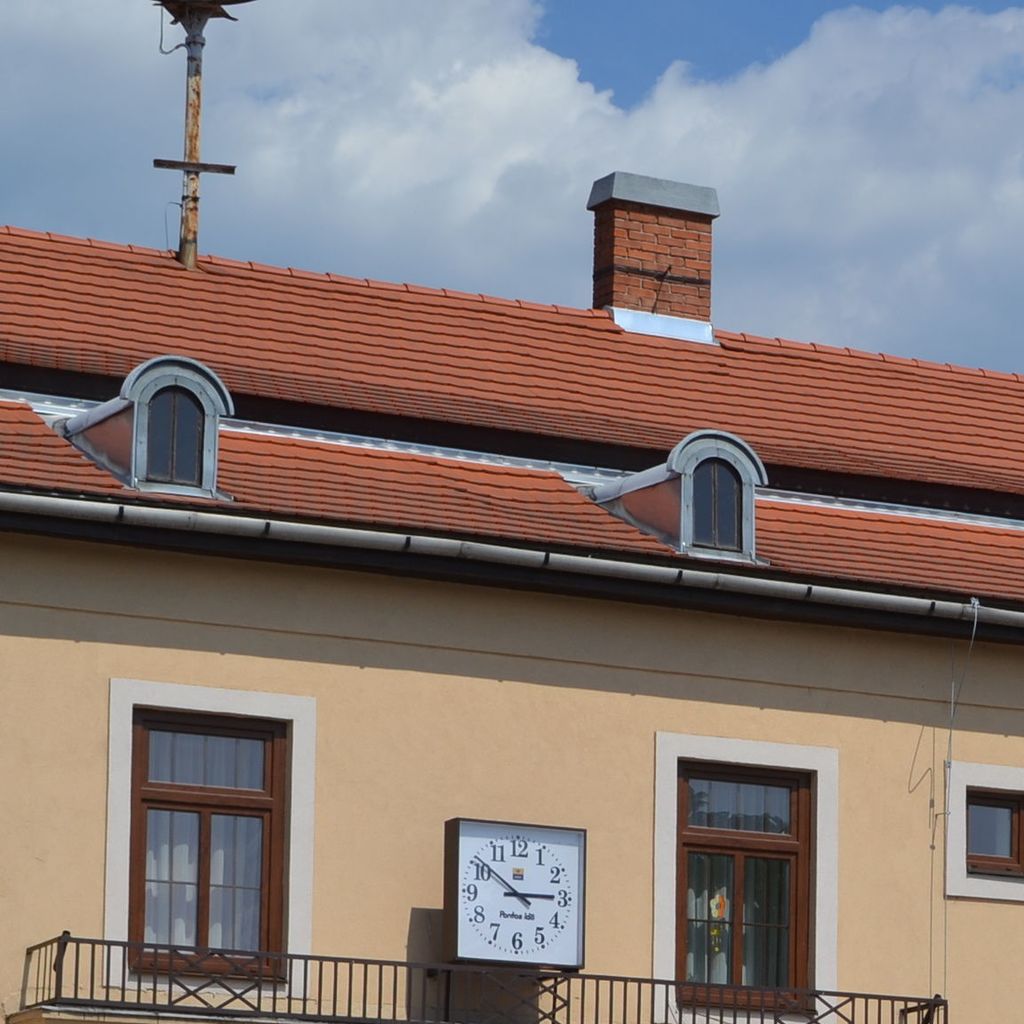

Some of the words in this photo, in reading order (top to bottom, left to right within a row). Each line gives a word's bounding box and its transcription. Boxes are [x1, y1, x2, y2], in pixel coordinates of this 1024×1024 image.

[491, 844, 505, 862] 11
[511, 839, 528, 858] 12
[536, 848, 545, 866] 1
[474, 862, 491, 881] 10
[550, 866, 561, 884] 2
[466, 884, 478, 902] 9
[558, 889, 568, 907] 3
[474, 905, 485, 923] 8
[499, 910, 522, 920] Pontos
[549, 911, 560, 929] 4
[489, 923, 500, 941] 7
[511, 932, 523, 950] 6
[534, 927, 545, 945] 5
